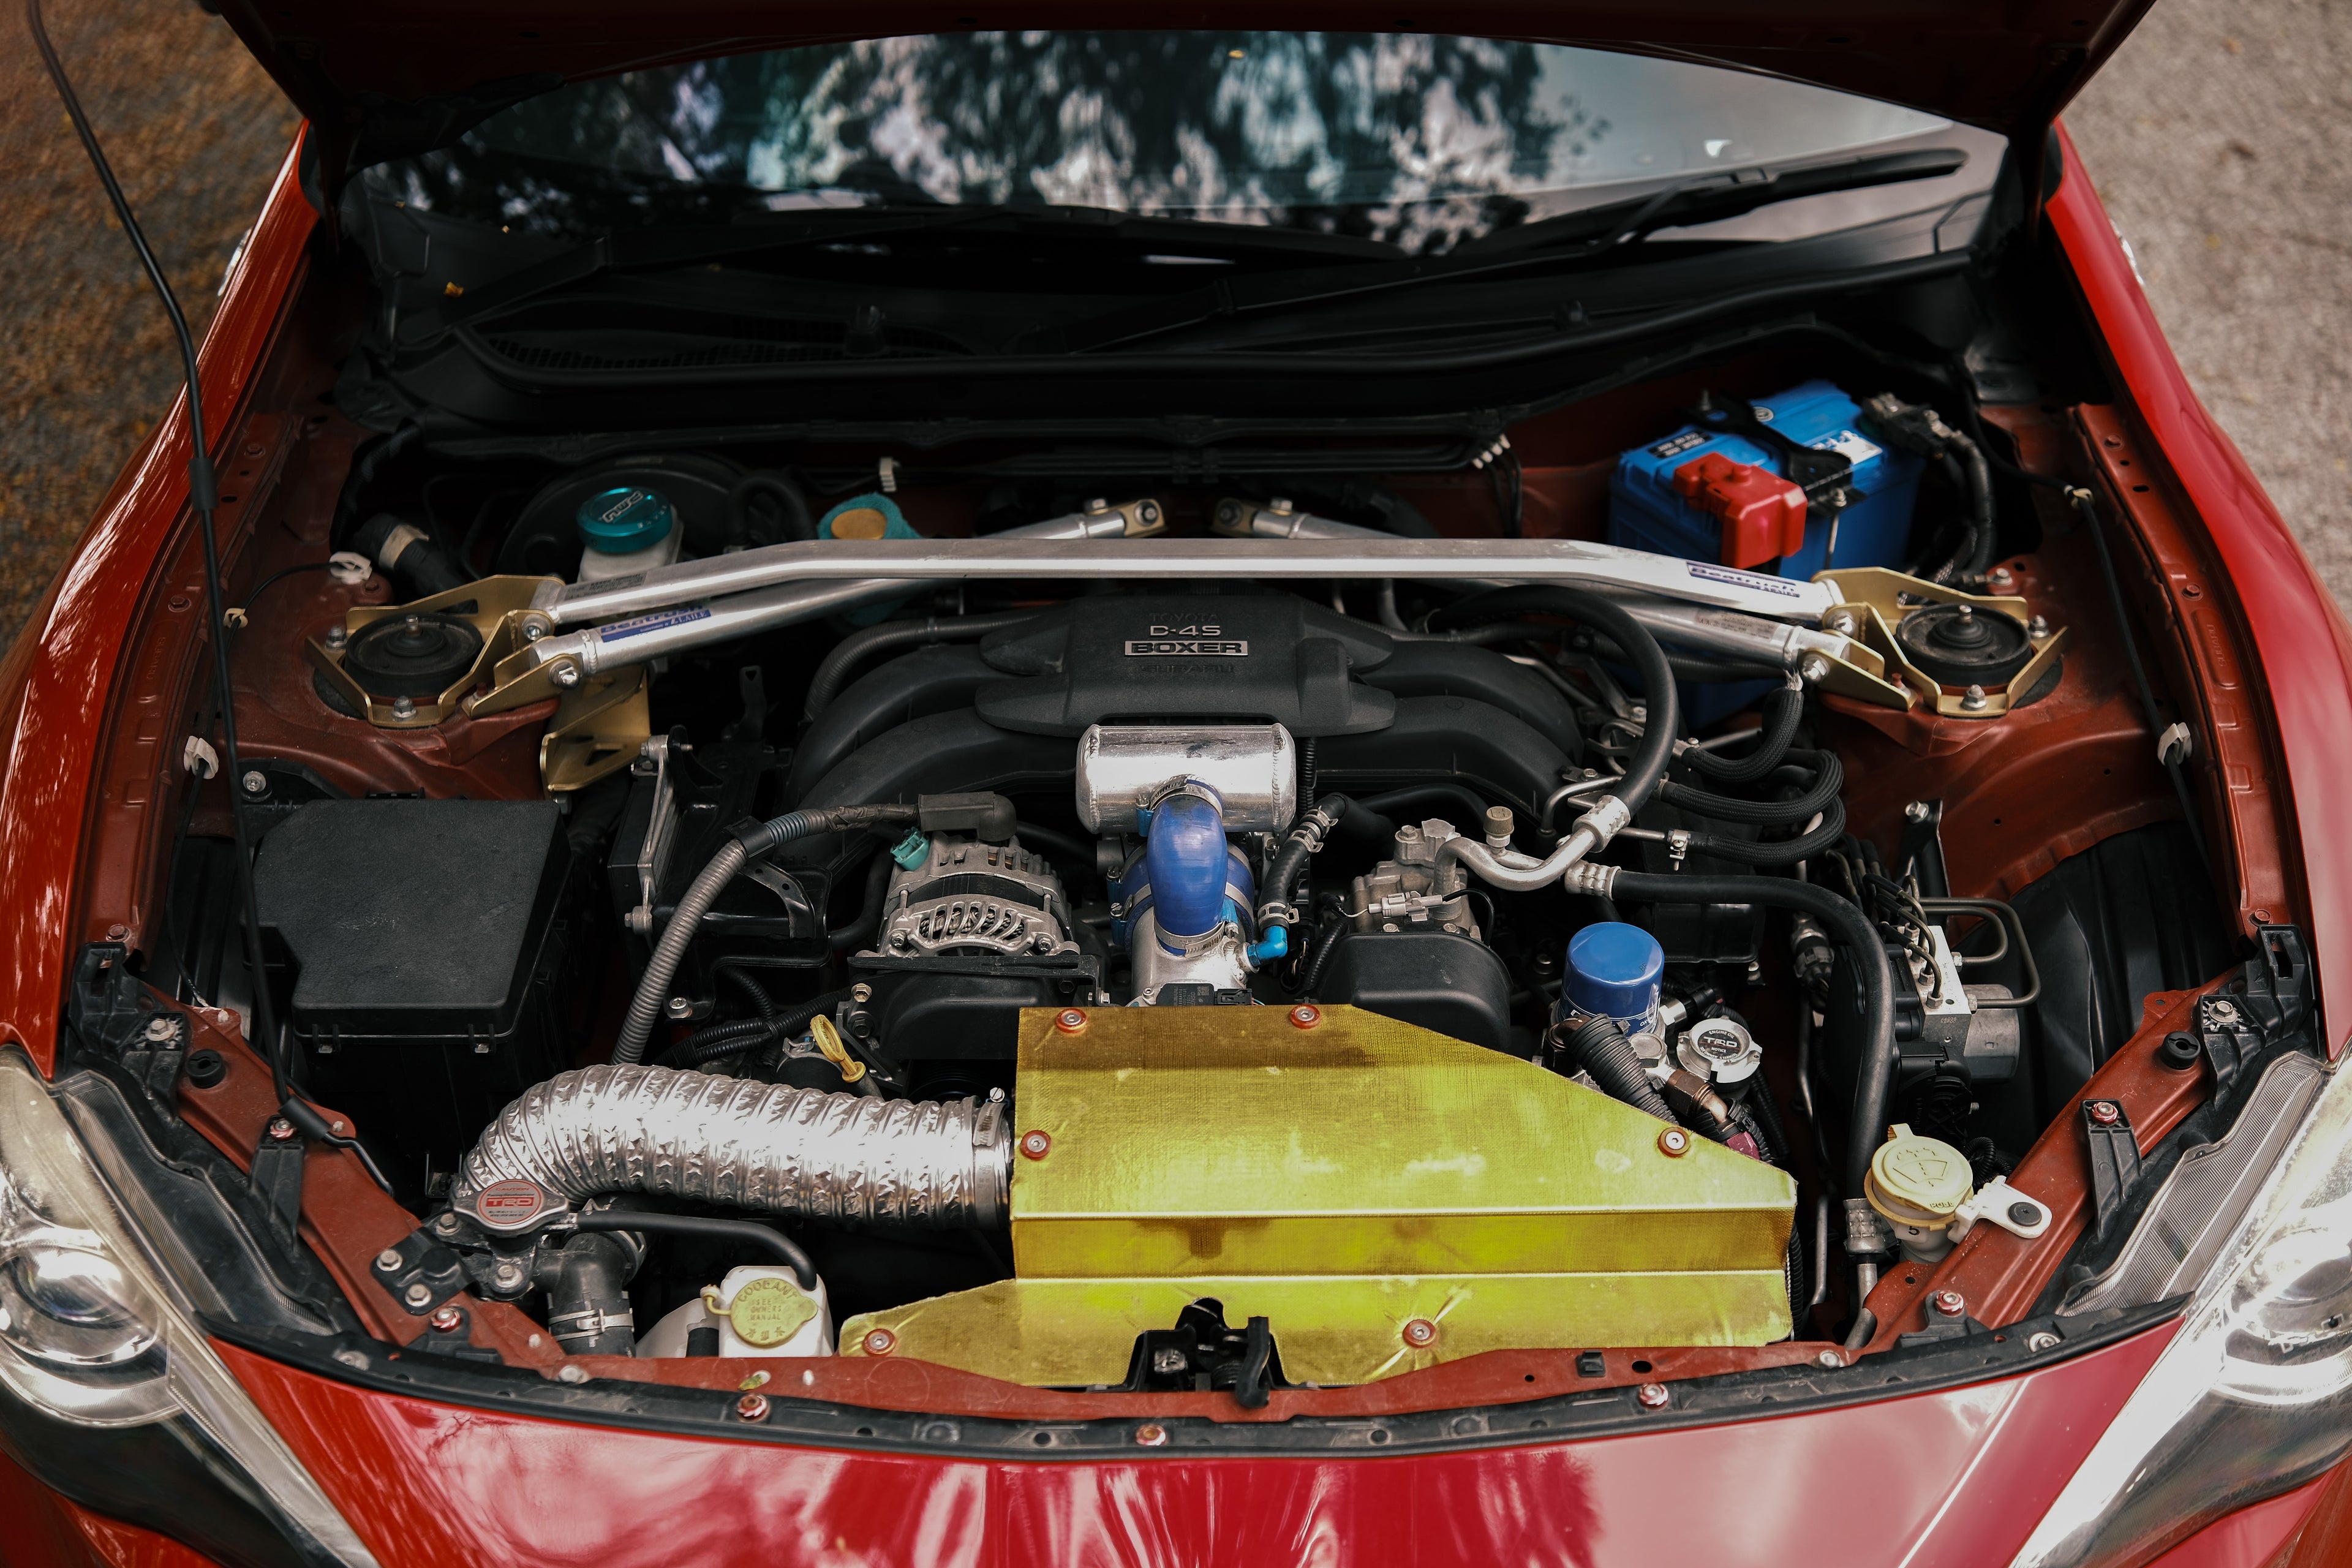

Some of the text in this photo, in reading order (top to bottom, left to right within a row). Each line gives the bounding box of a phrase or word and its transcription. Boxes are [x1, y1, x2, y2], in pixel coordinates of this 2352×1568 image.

[1148, 612, 1221, 622] TOYOTA
[1150, 625, 1221, 636] D-4S
[1131, 642, 1242, 654] BOXER
[1141, 665, 1235, 674] SUBARU
[1703, 1036, 1738, 1048] TRD
[486, 1197, 534, 1207] TRD
[1908, 1225, 1920, 1235] 5
[748, 1313, 782, 1322] MANUAL
